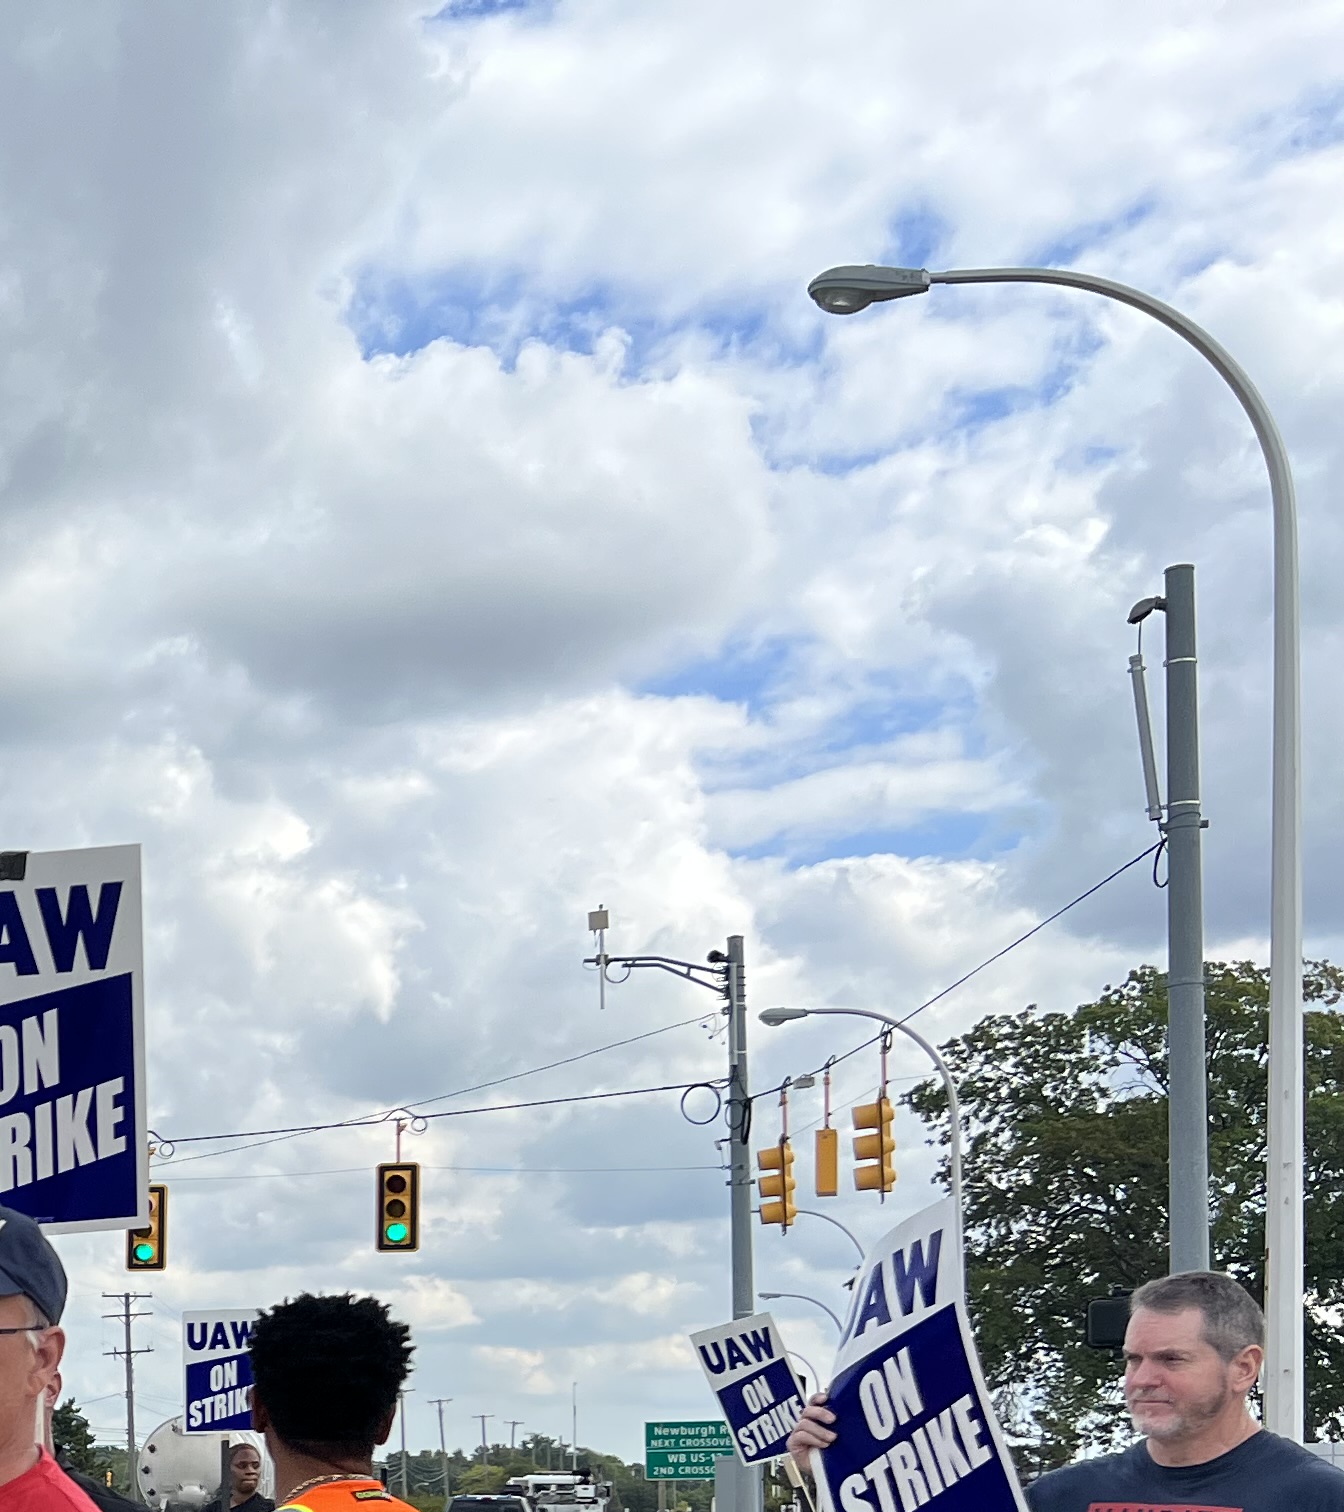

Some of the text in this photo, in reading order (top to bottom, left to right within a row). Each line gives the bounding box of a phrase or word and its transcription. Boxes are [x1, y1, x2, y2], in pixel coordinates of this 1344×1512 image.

[841, 1229, 943, 1348] AW
[698, 1326, 775, 1375] UAW
[209, 1359, 238, 1392] ON
[858, 1345, 925, 1442] ON
[741, 1374, 775, 1415] ON
[650, 1437, 732, 1448] NEXT CROSSOVE
[654, 1425, 730, 1438] Newburgh R
[737, 1394, 804, 1457] STRIKE
[653, 1466, 716, 1475] 2ND CROSSO
[667, 1453, 723, 1463] WB US-1
